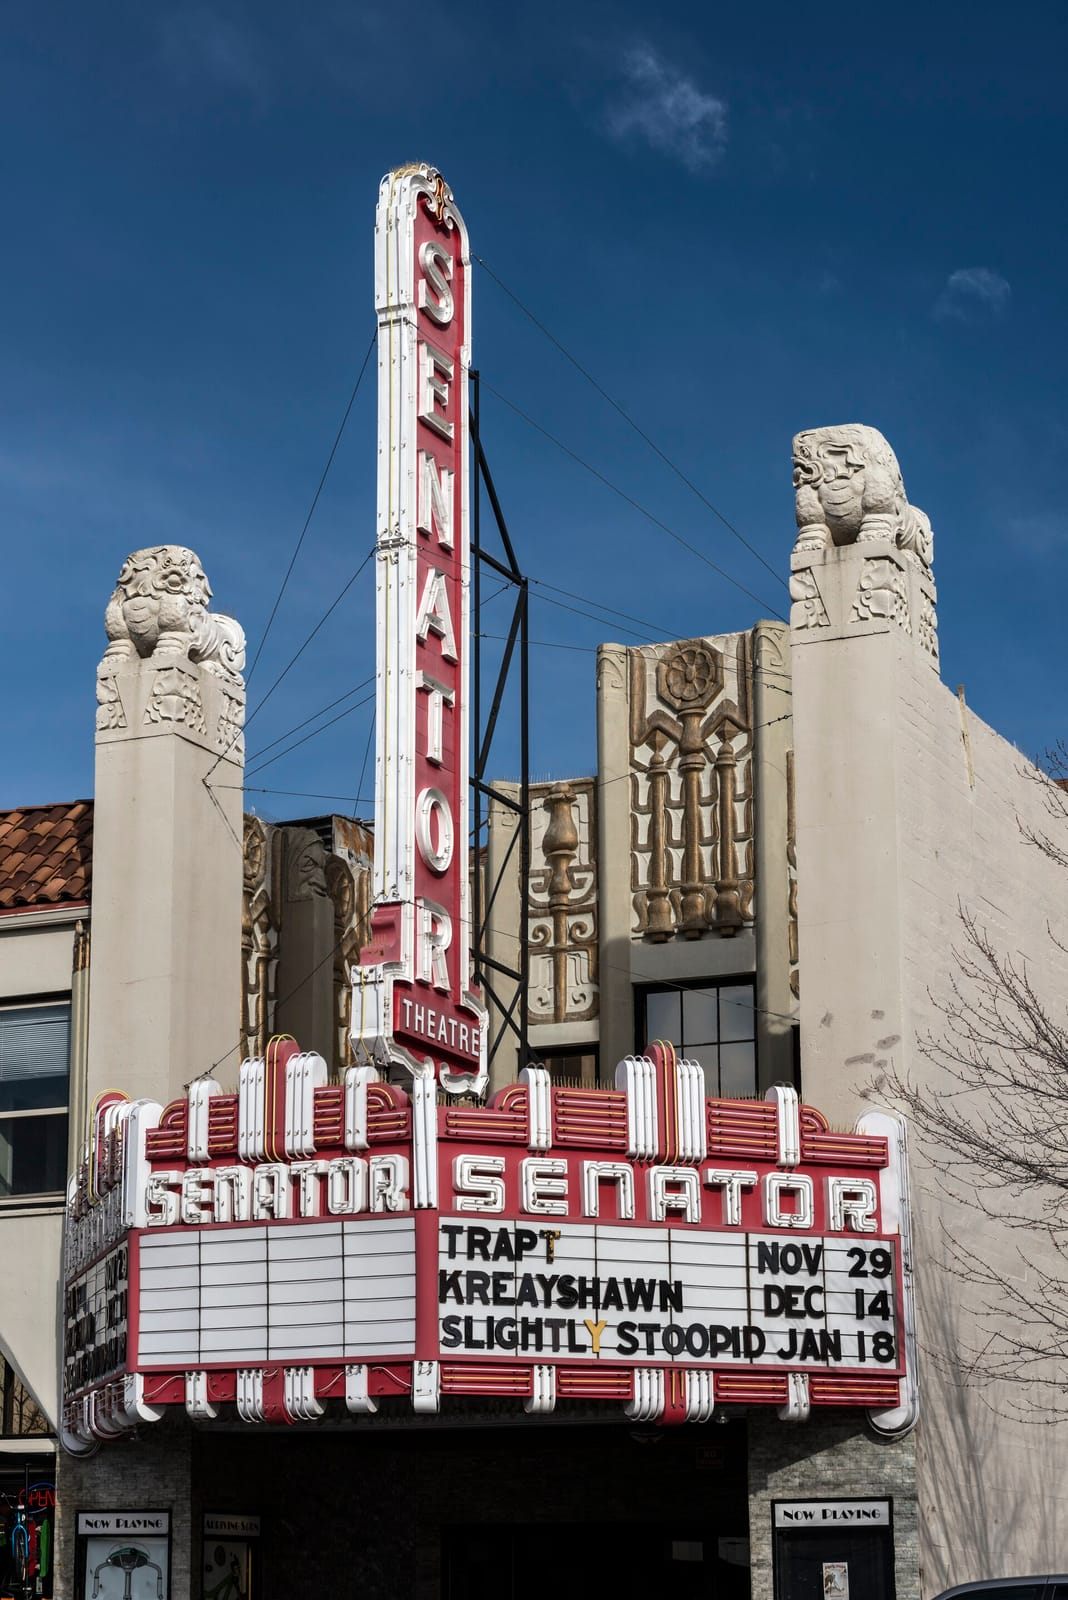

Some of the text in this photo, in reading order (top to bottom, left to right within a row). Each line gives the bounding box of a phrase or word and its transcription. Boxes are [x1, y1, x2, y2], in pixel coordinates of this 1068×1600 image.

[415, 241, 459, 993] SENATOR
[402, 998, 480, 1057] THEATRE
[145, 1154, 409, 1227] SENATOR
[452, 1154, 878, 1232] SENATOR
[440, 1224, 892, 1278] TRAPT NOV 29
[439, 1269, 890, 1321] KREAYSHAWN DEC 14
[441, 1314, 895, 1363] SLIGHTLY STOOPID JAN 18
[85, 1517, 163, 1529] NOW PLAYING
[783, 1508, 881, 1521] NOW PLAYING
